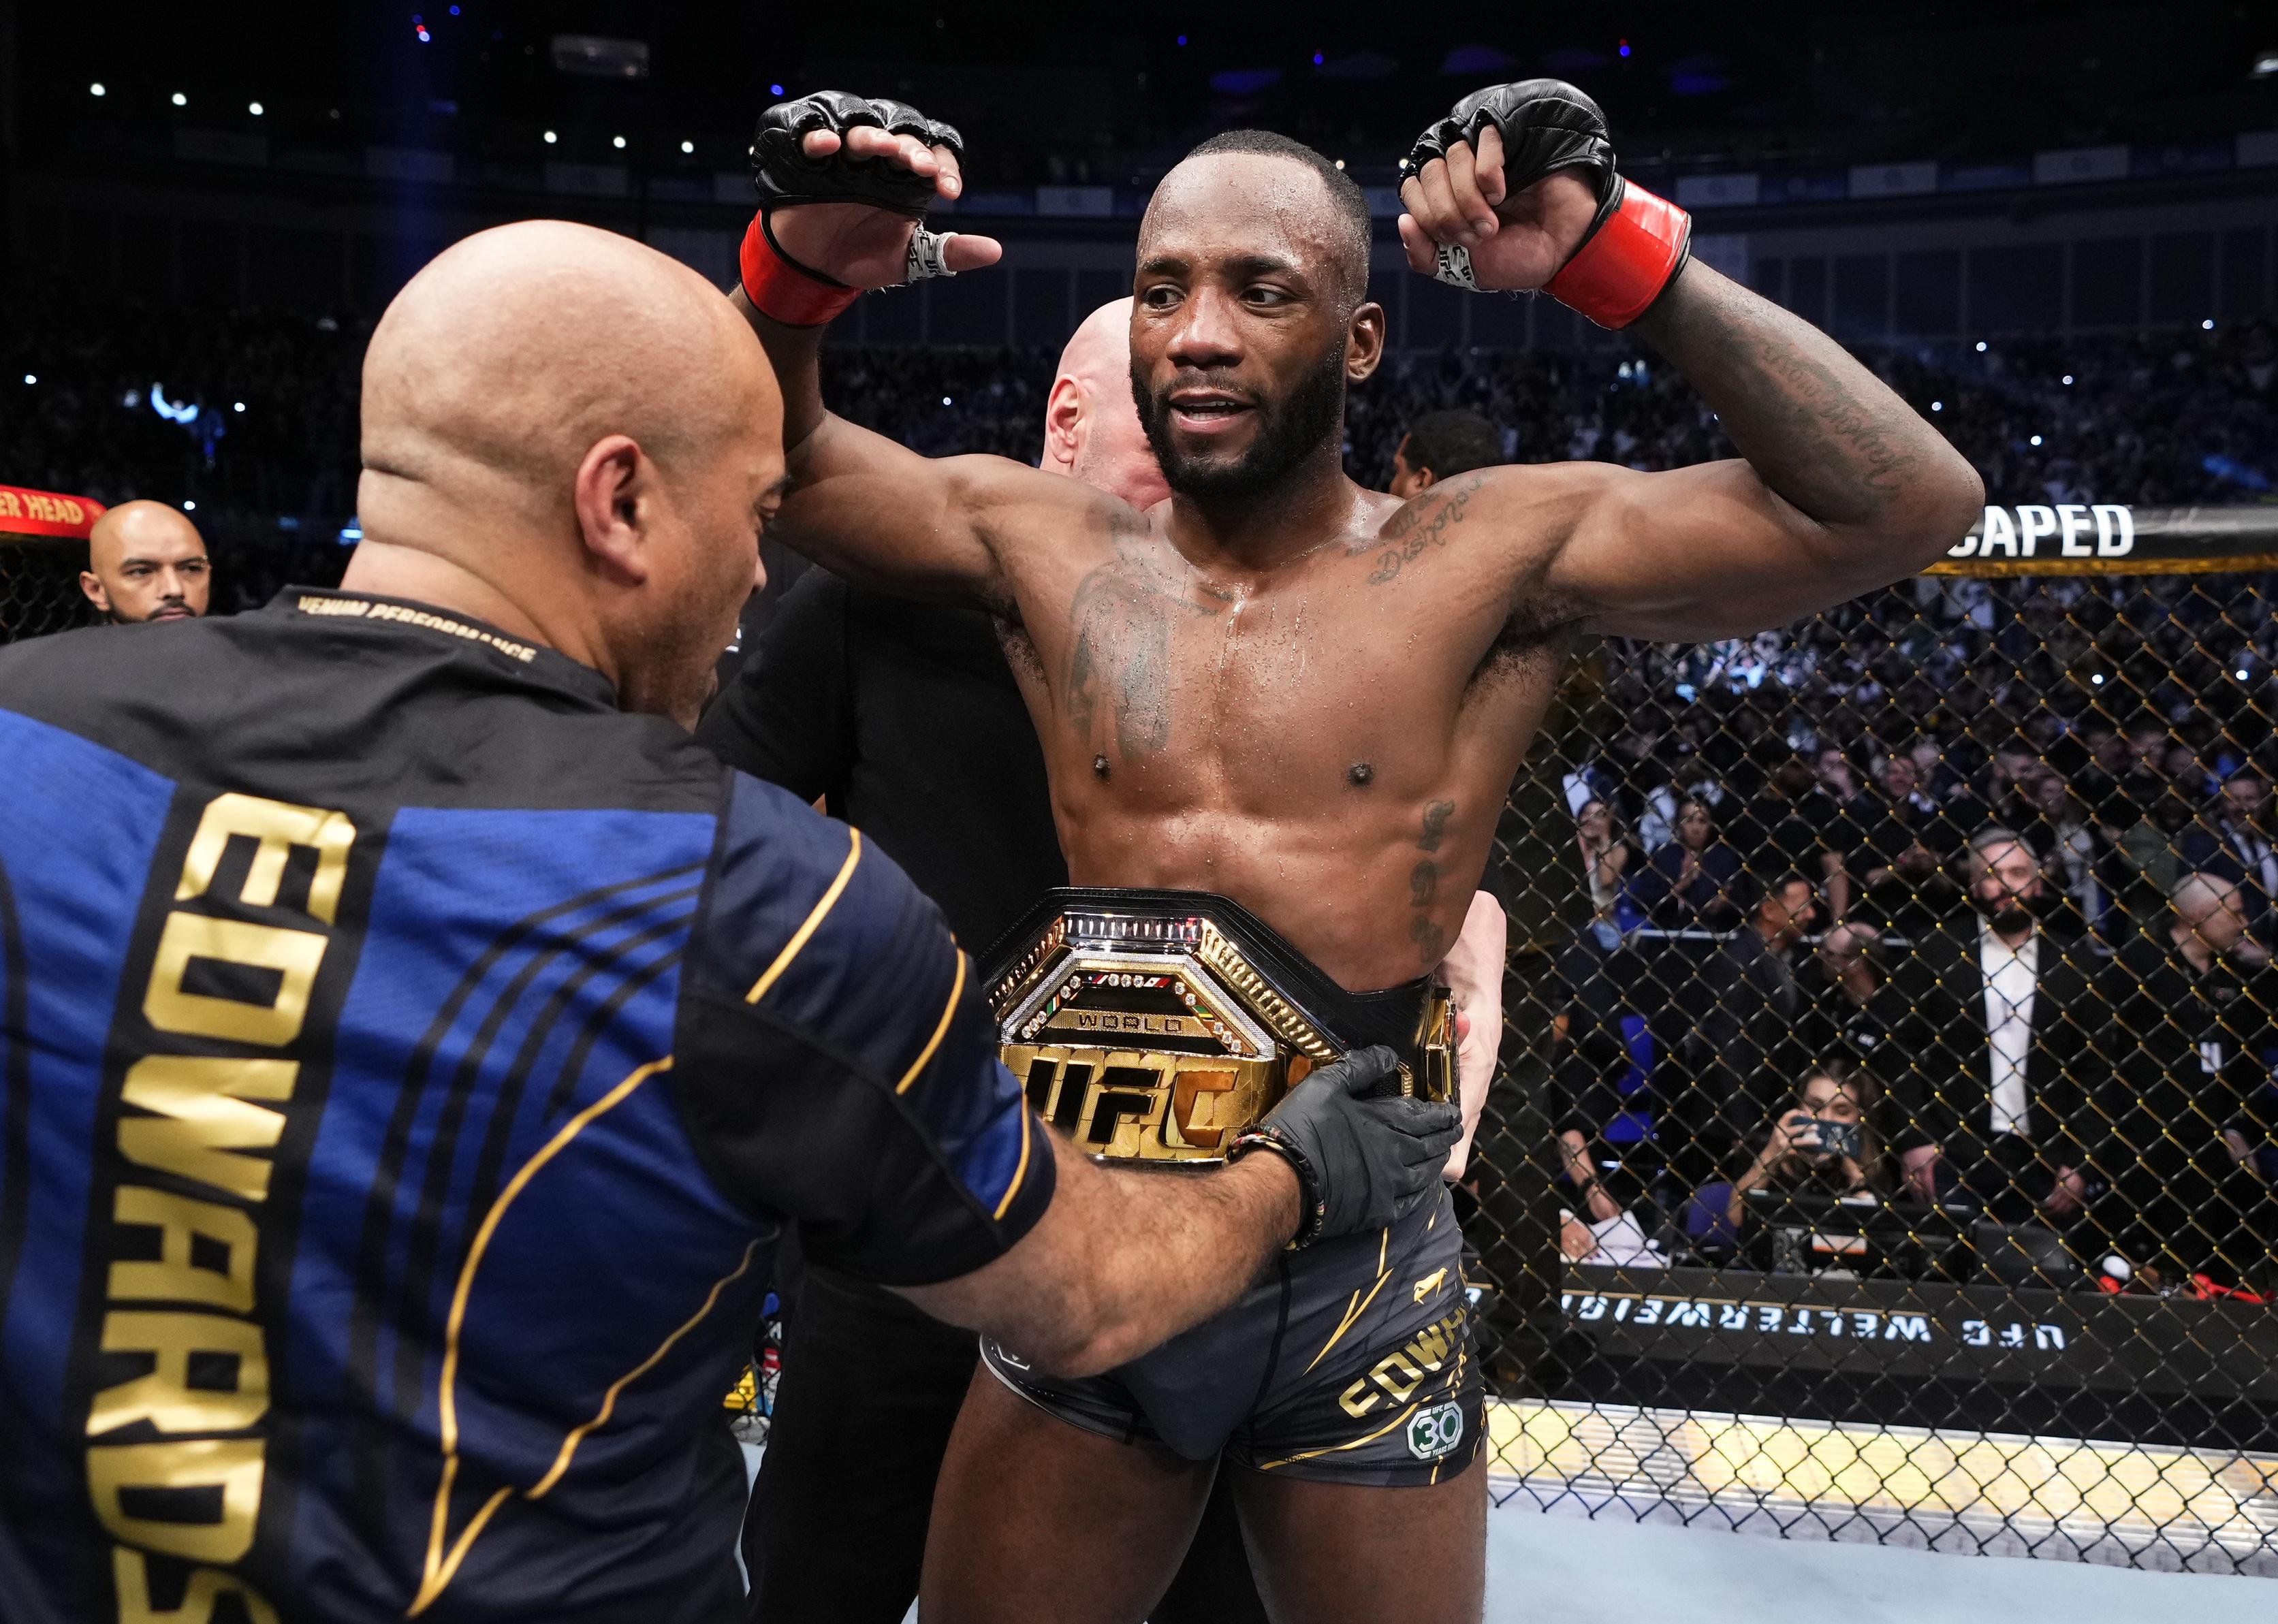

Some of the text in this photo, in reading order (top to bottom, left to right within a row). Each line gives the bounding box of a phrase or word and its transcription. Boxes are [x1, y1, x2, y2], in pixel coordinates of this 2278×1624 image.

[21, 493, 84, 525] HEAD
[298, 595, 370, 617] VENUM
[1079, 1014, 1182, 1032] WORLD
[1024, 1057, 1238, 1149] UFC
[1963, 1319, 2065, 1350] UFC
[1431, 1405, 1444, 1414] UFC
[1417, 1407, 1459, 1452] 30
[1431, 1445, 1448, 1456] YEARS
